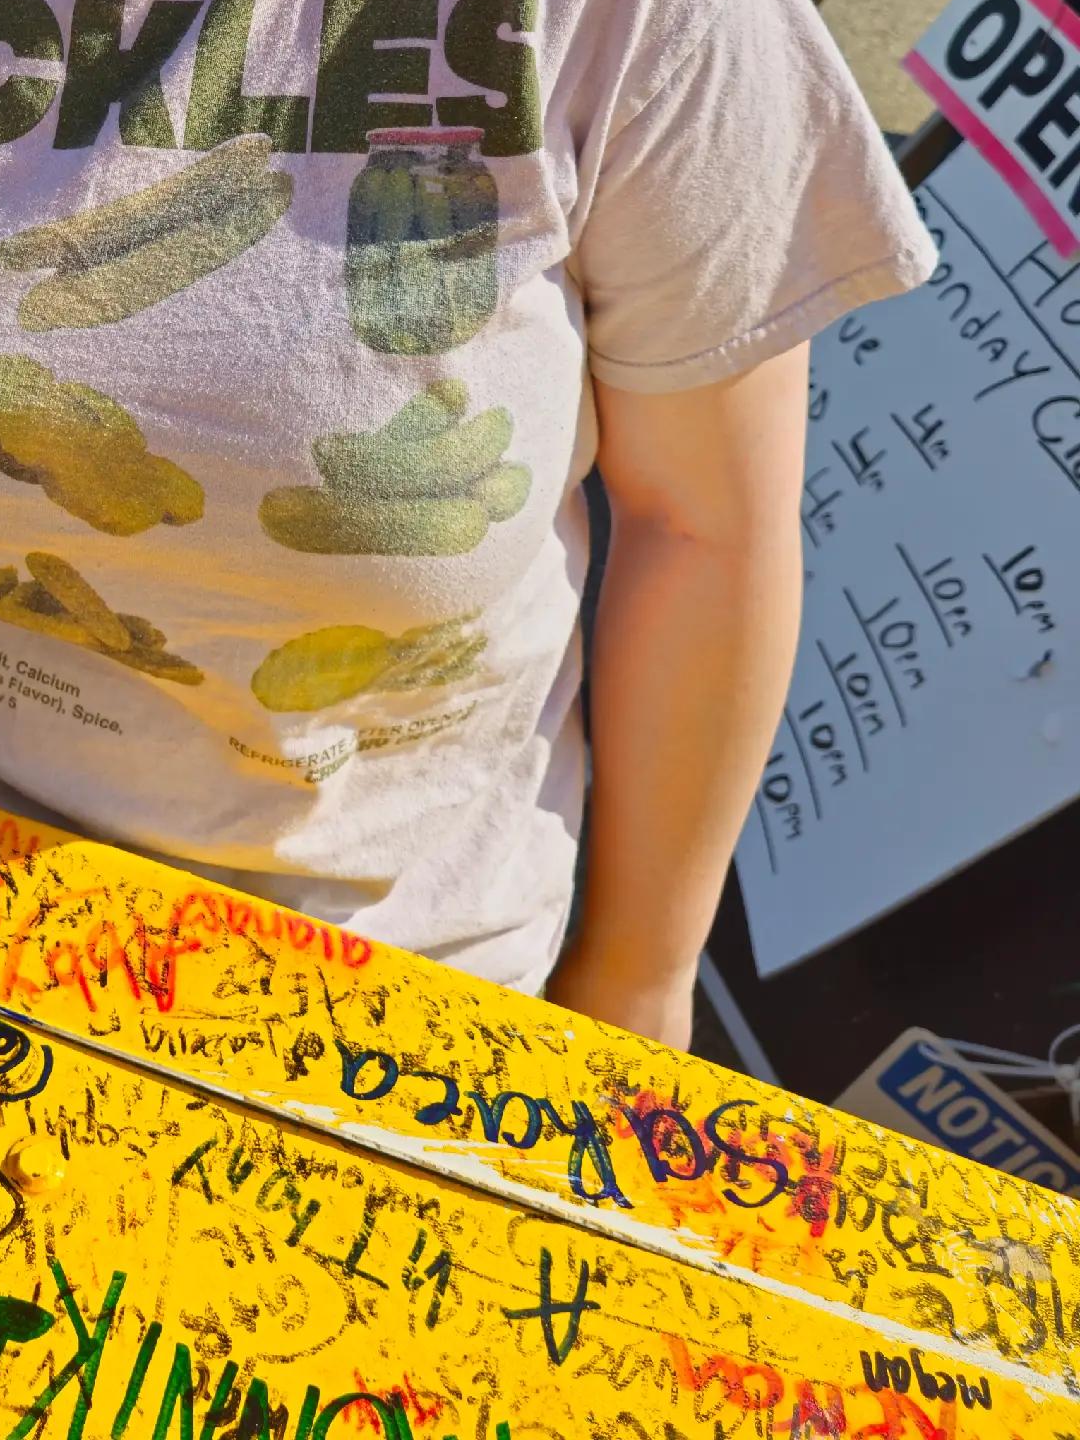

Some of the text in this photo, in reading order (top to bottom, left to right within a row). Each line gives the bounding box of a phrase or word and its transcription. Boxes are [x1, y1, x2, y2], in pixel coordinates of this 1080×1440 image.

[16, 661, 81, 698] Calcium
[8, 695, 17, 710] 5
[8, 676, 66, 715] Flavor),
[72, 703, 124, 736] Spice,
[228, 735, 347, 770] REFRIGERATE
[859, 1347, 993, 1410] Megan
